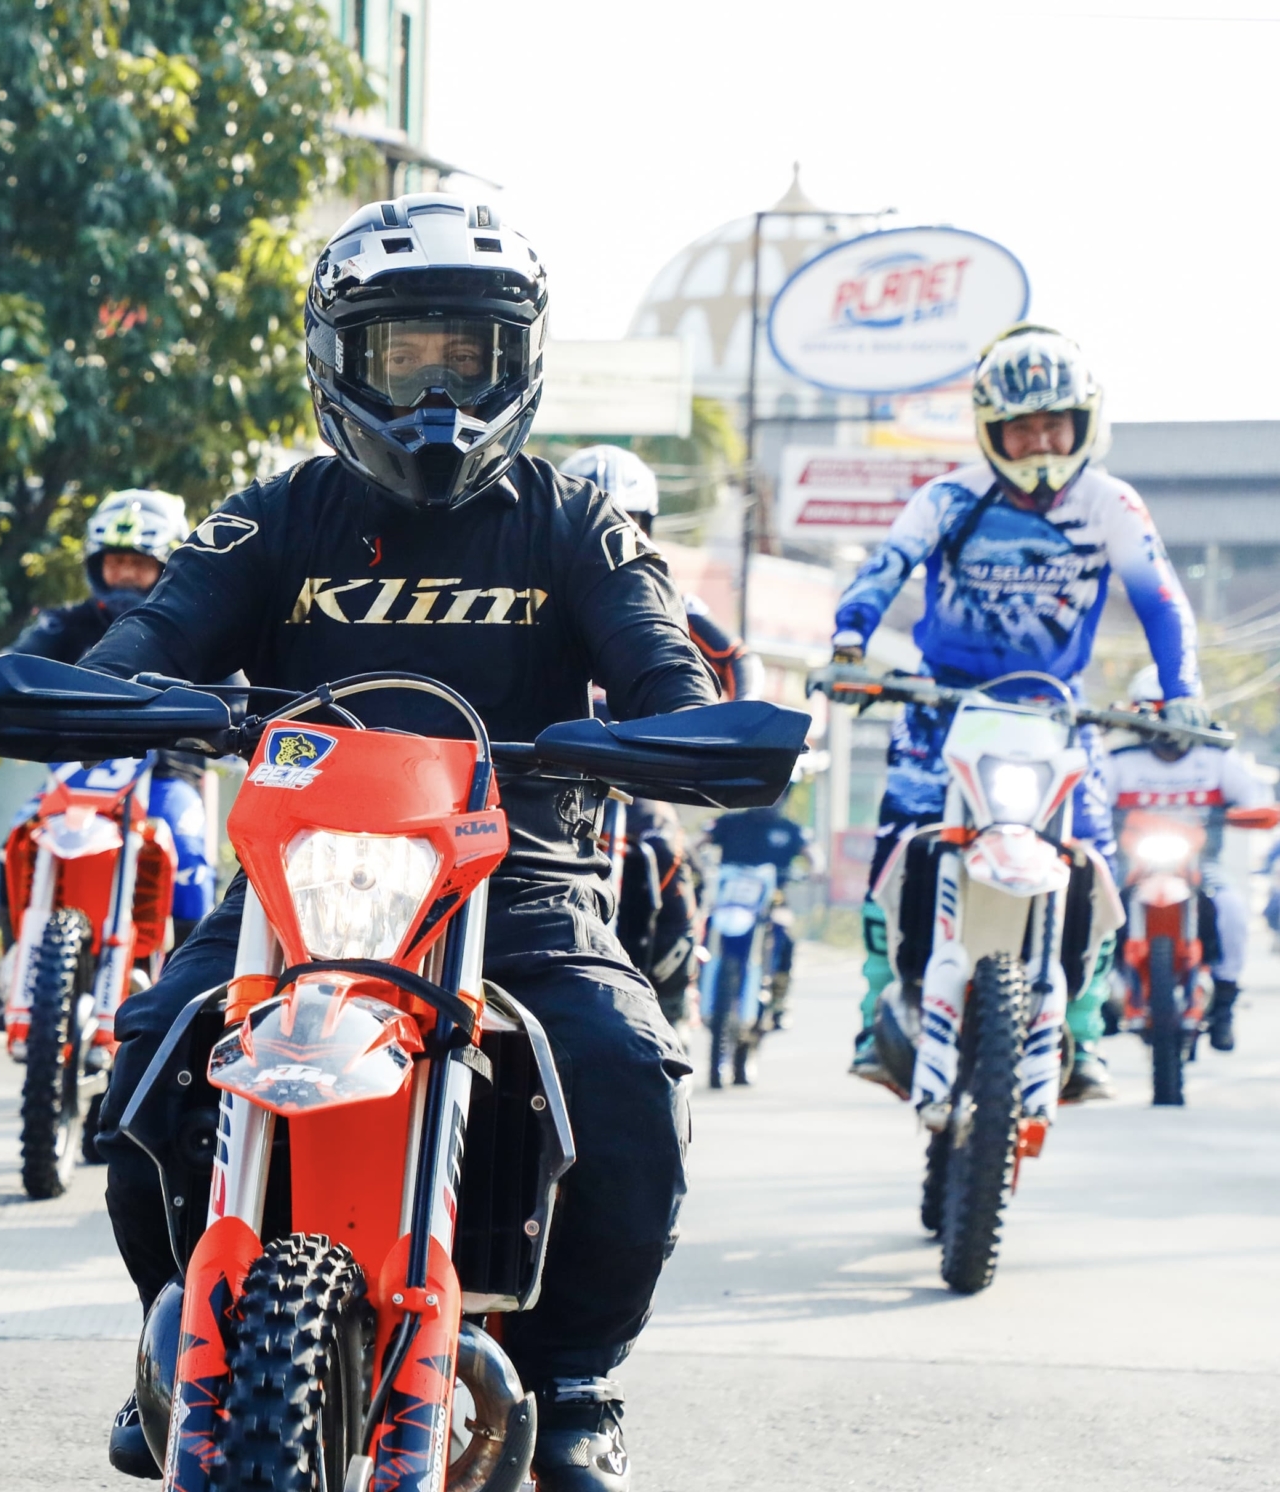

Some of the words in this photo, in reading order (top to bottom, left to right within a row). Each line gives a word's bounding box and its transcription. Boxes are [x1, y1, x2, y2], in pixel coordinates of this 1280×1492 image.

[831, 257, 972, 320] PLANET
[249, 764, 322, 785] PETE
[455, 820, 498, 837] KTM
[253, 1064, 338, 1087] KTM
